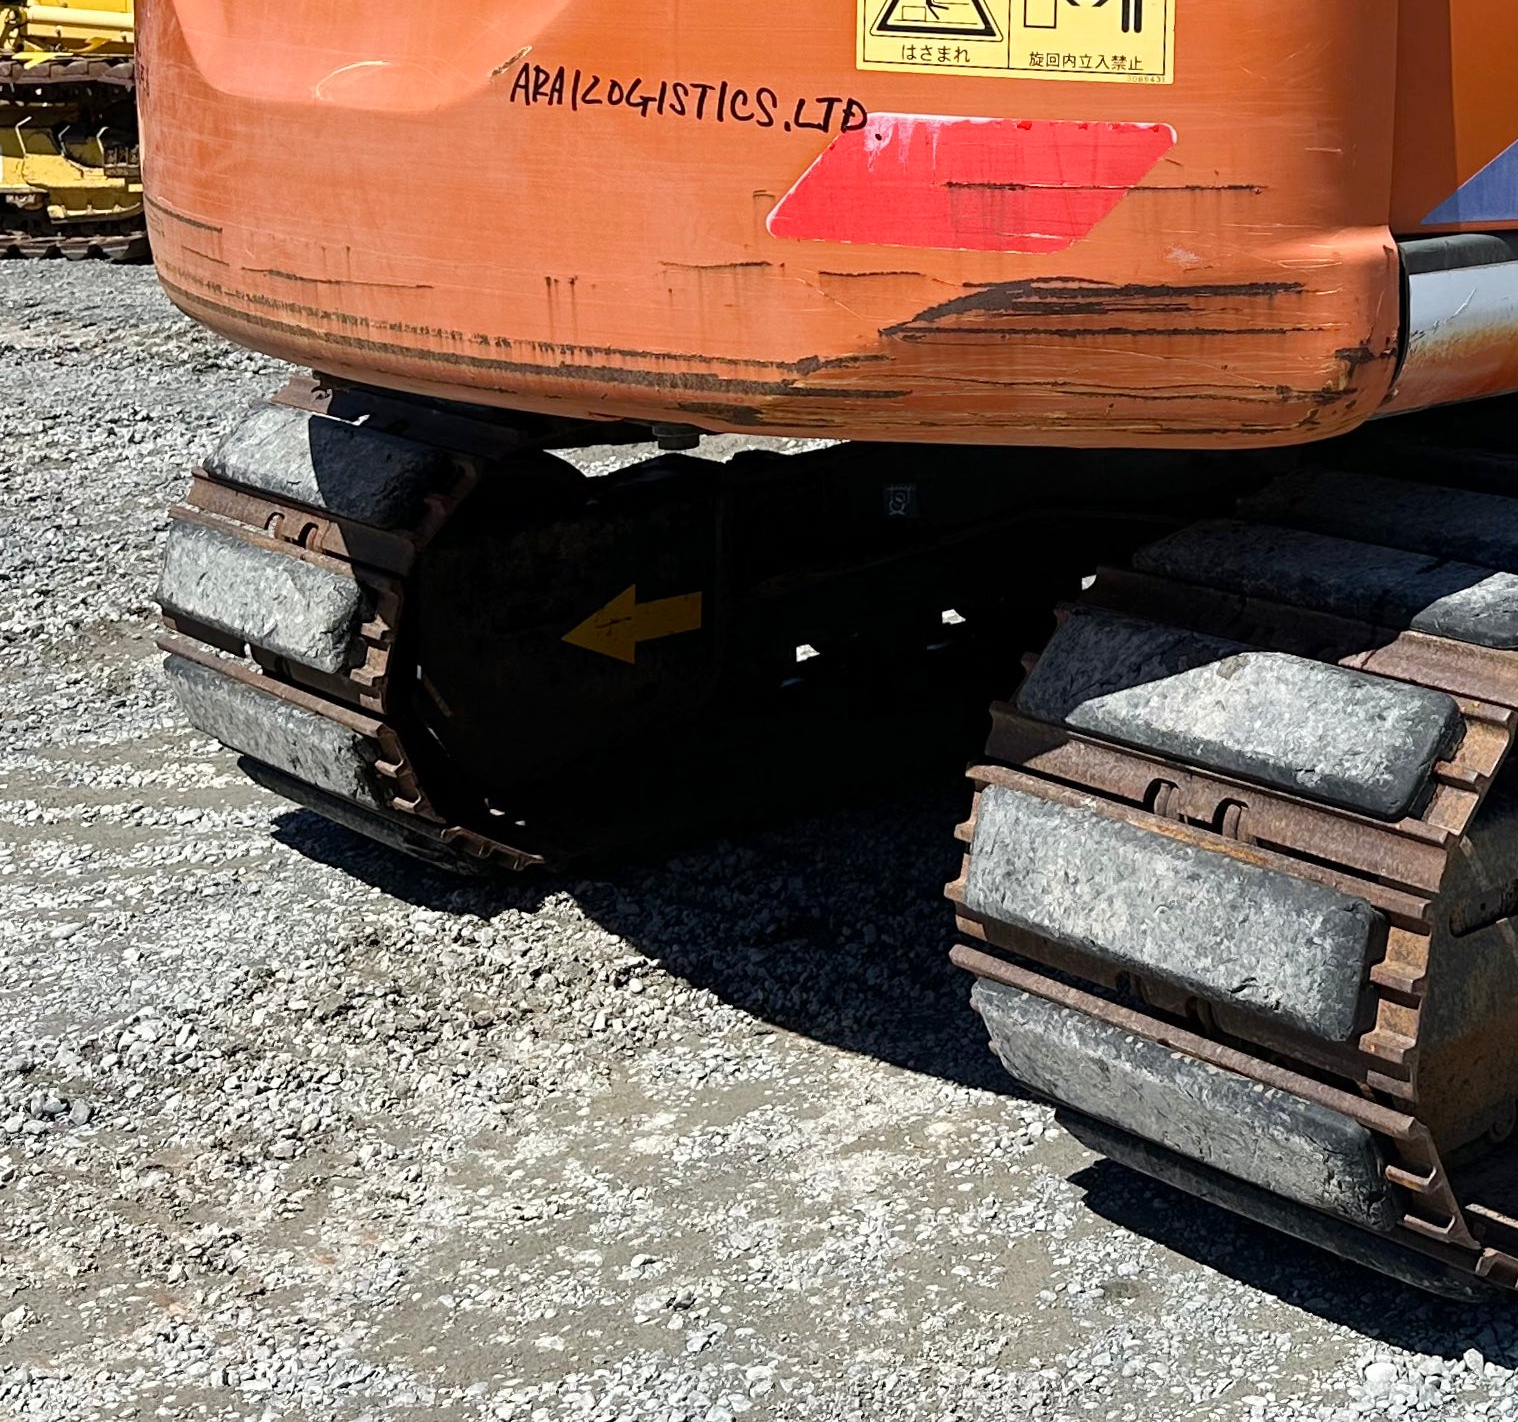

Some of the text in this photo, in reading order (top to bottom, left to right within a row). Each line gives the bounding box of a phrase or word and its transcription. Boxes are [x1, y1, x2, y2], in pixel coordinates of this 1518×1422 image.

[901, 43, 971, 64] はさまれ
[1028, 51, 1144, 72] 旋回内立入禁止
